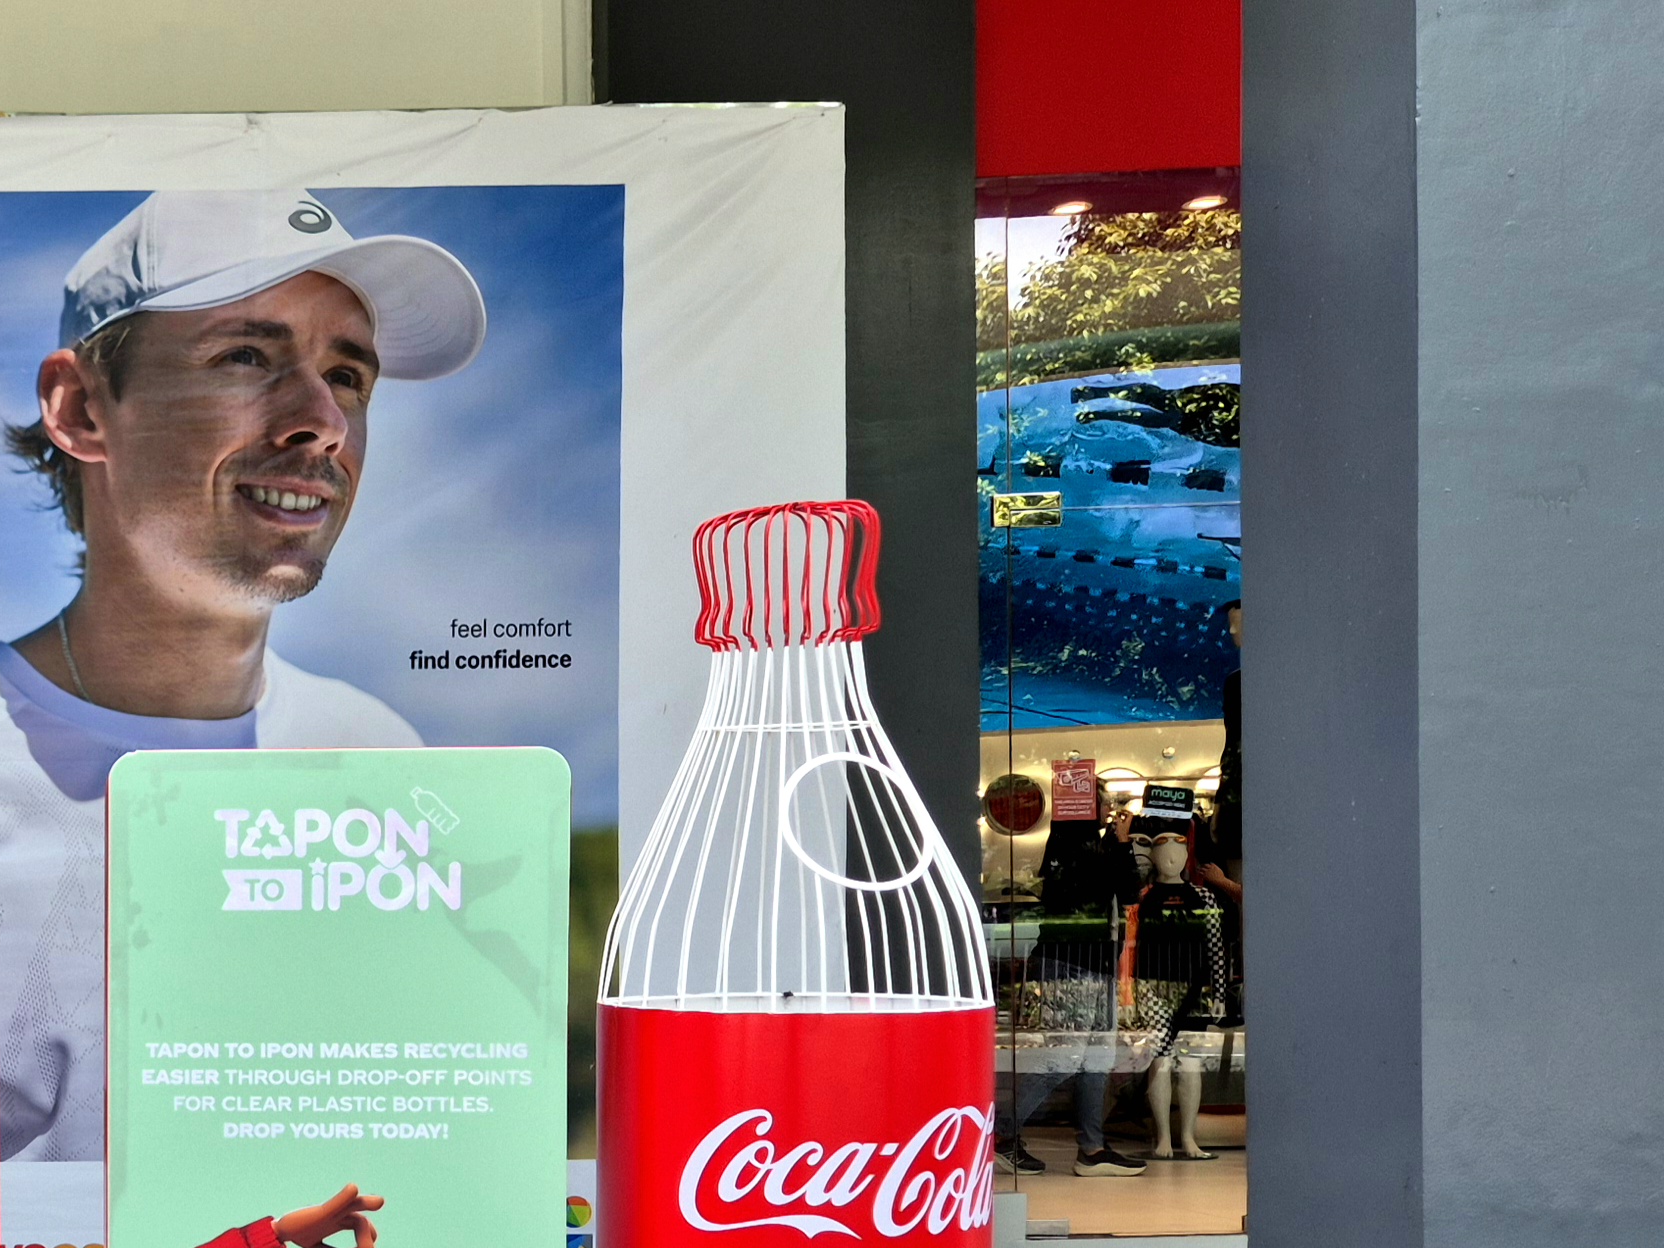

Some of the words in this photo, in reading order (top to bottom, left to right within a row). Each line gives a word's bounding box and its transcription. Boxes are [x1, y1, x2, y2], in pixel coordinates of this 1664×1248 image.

[450, 618, 487, 638] feel
[493, 618, 572, 638] comfort
[409, 650, 450, 670] find
[455, 649, 572, 670] confidence
[1151, 789, 1185, 801] maya
[244, 878, 285, 902] TO
[145, 1043, 219, 1058] TAPON
[224, 1043, 255, 1058] TO
[260, 1043, 313, 1058] IPON
[320, 1043, 398, 1058] MAKES
[404, 1043, 529, 1058] RECYCLING
[142, 1069, 220, 1085] EASIER
[224, 1069, 331, 1085] THROUGH
[338, 1070, 448, 1085] DROP-OFF
[454, 1070, 533, 1085] POINTS
[174, 1096, 216, 1111] FOR
[221, 1096, 292, 1111] CLEAR
[299, 1096, 386, 1112] PLASTIC
[393, 1096, 494, 1112] BOTTLES.
[224, 1123, 285, 1139] DROP
[290, 1123, 364, 1139] YOURS
[369, 1123, 449, 1139] TODAY!
[679, 1101, 994, 1240] Coca-Cola
